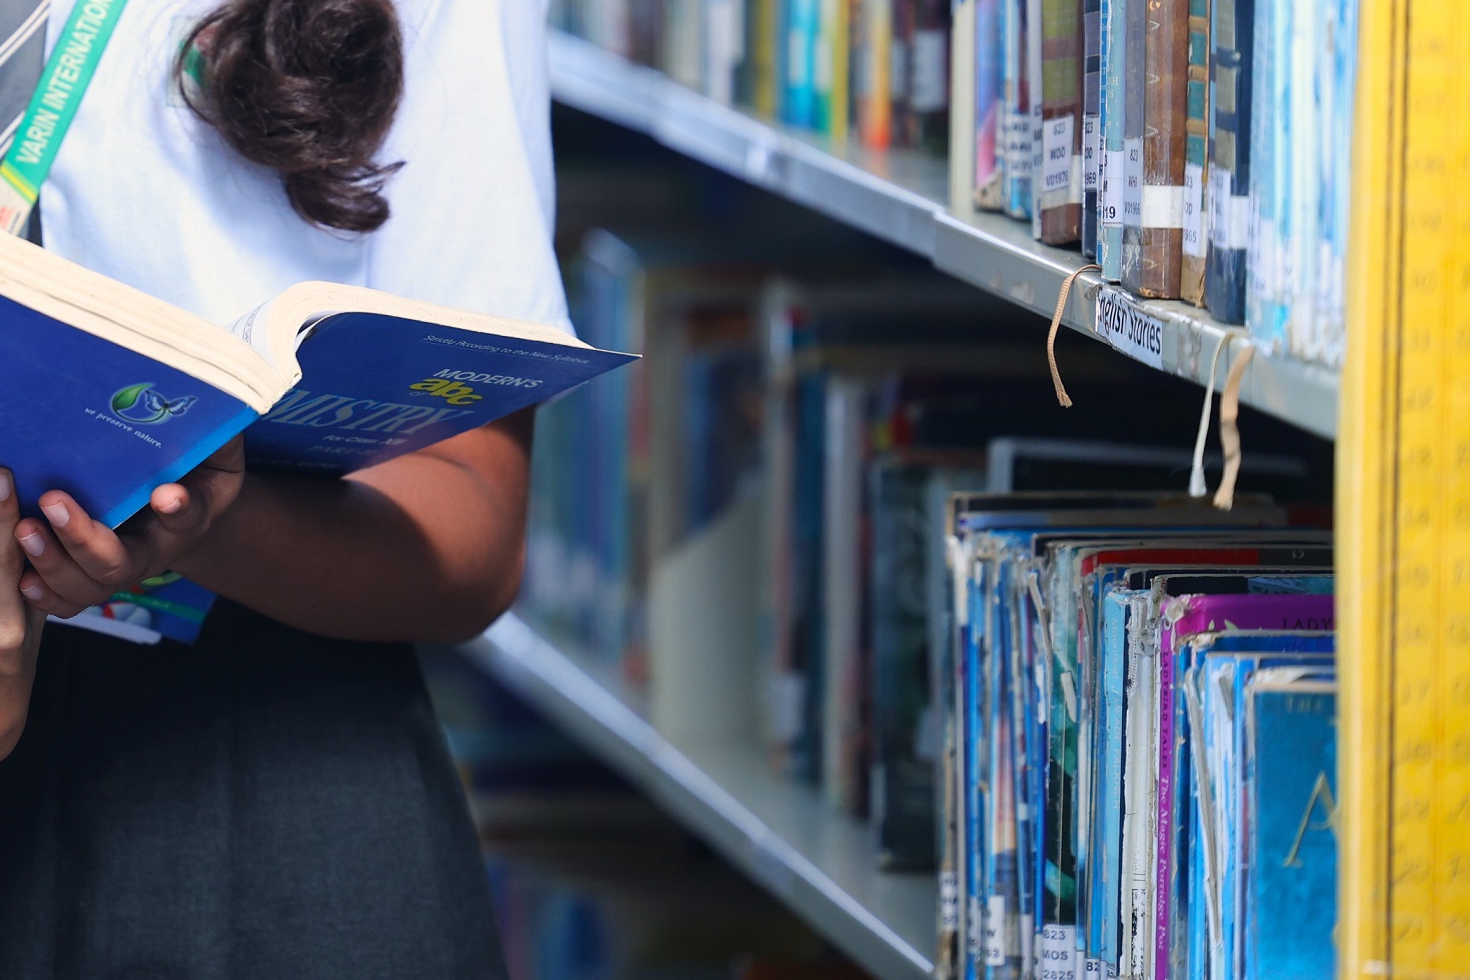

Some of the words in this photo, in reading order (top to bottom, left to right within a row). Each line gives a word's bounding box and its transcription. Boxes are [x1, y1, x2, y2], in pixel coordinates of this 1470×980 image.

[16, 85, 61, 165] VARIN
[1185, 176, 1193, 189] 23
[1128, 306, 1161, 355] Stories
[409, 378, 483, 405] abc
[433, 368, 544, 388] MODERN'S
[95, 413, 133, 432] preserve
[134, 430, 162, 449] nature.
[1160, 775, 1169, 799] The
[1158, 803, 1168, 852] Magic
[1158, 856, 1168, 928] Porridge
[1043, 929, 1066, 941] 823
[1158, 931, 1167, 950] Pot
